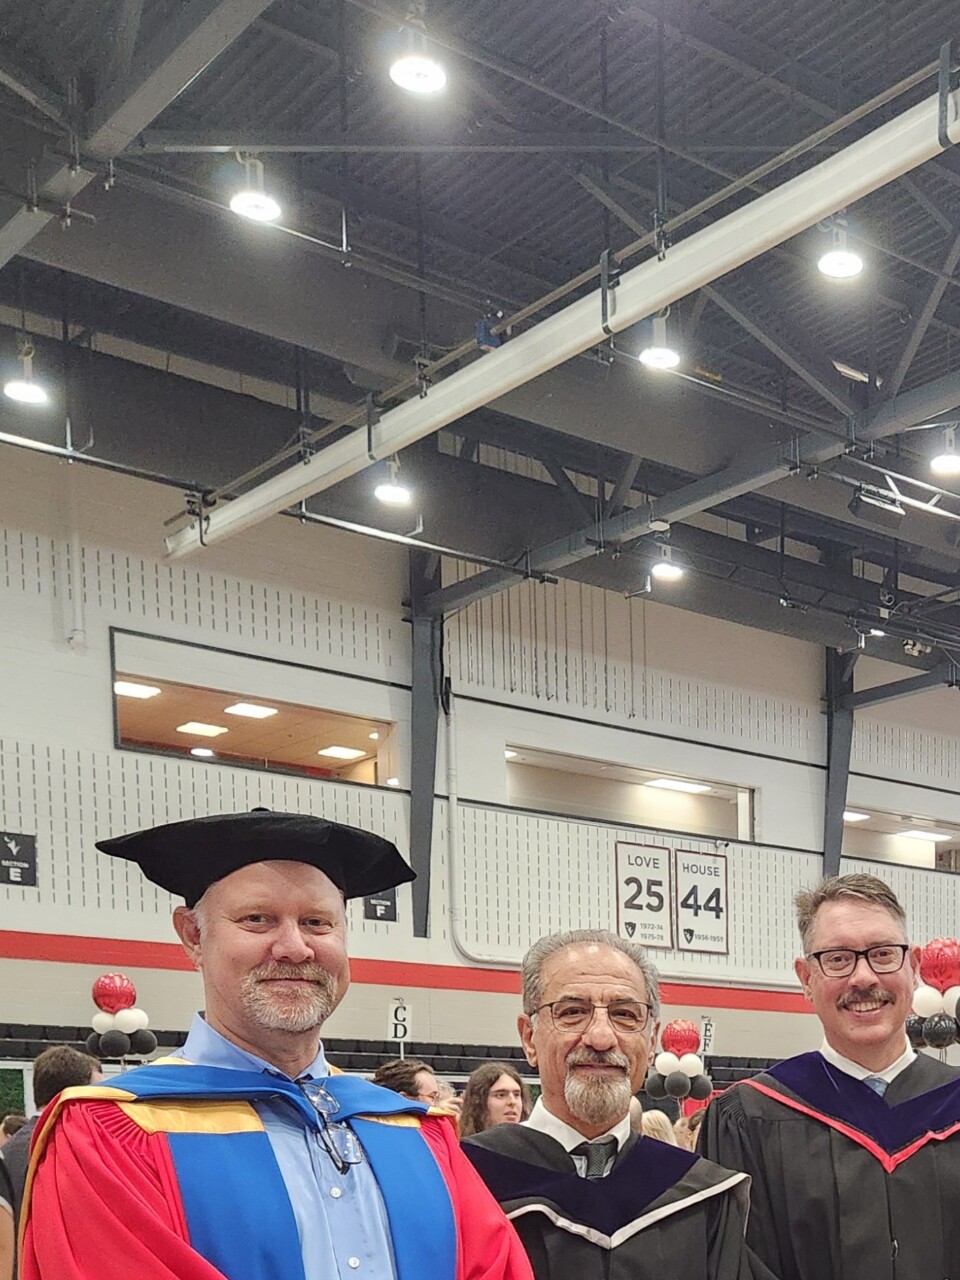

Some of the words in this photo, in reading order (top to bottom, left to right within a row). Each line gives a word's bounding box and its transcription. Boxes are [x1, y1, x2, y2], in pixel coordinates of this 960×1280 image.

[627, 854, 660, 869] LOVE
[9, 867, 22, 881] E
[682, 862, 720, 877] HOUSE
[623, 876, 664, 912] 25
[680, 884, 724, 919] 44
[376, 905, 386, 917] F
[394, 1005, 407, 1022] C
[392, 1022, 408, 1039] D
[703, 1022, 713, 1038] E
[702, 1037, 711, 1052] F
